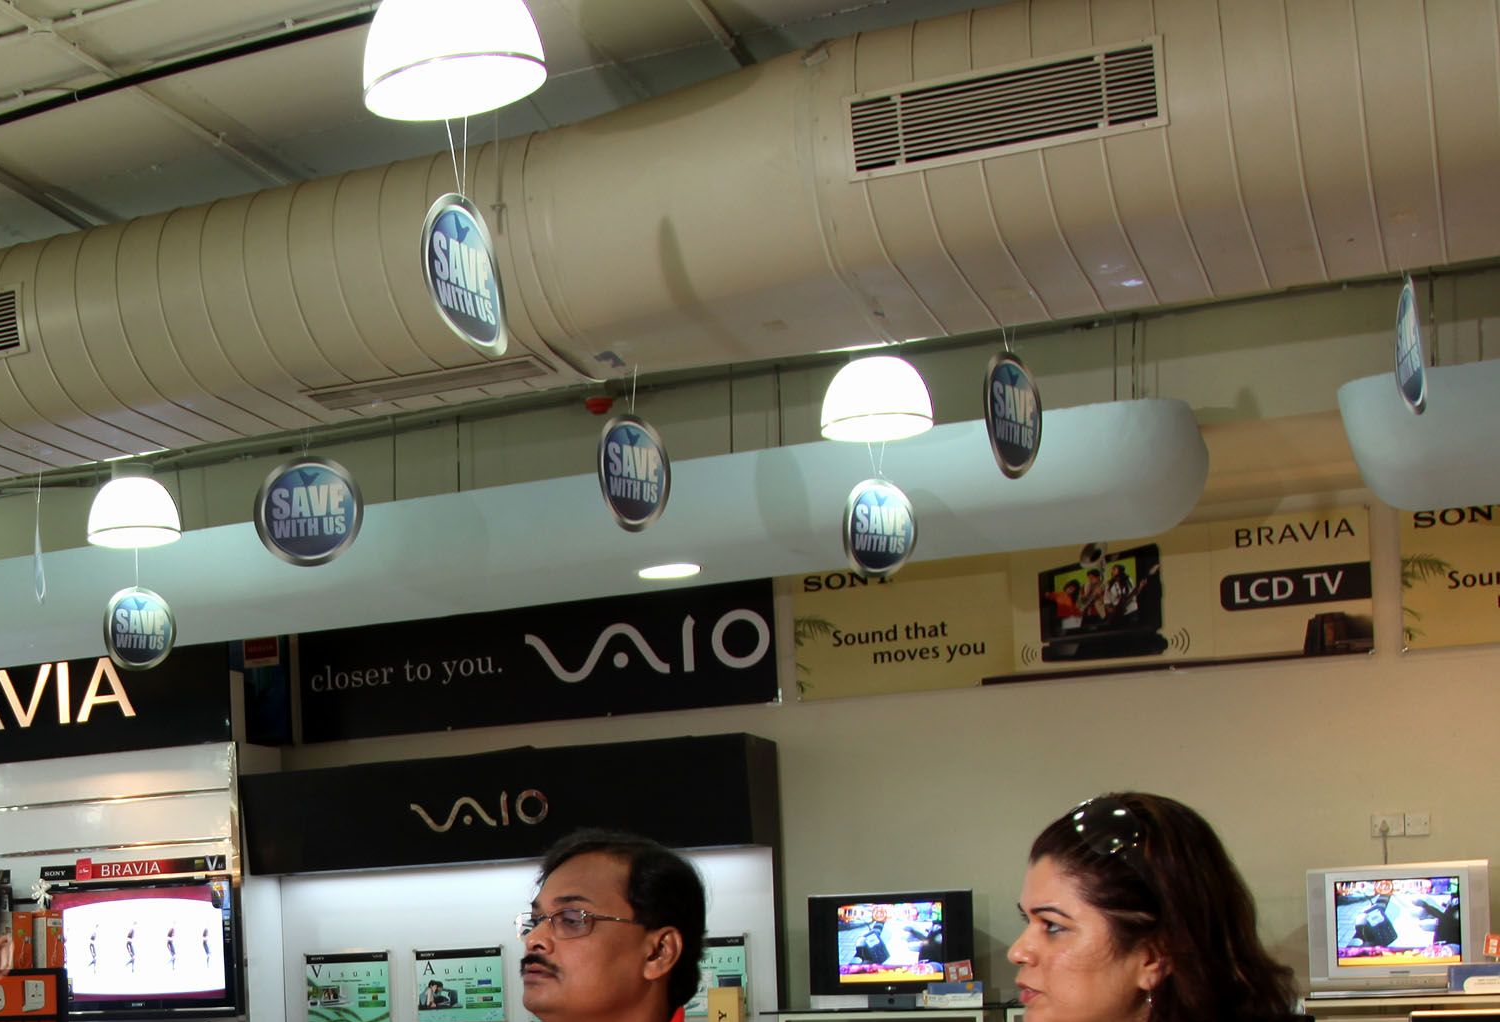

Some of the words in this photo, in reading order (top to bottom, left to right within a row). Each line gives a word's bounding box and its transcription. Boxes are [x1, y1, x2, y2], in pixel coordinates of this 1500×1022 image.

[432, 231, 491, 299] SAVE
[435, 279, 477, 318] WITH
[476, 295, 496, 326] US
[992, 380, 1036, 428] SAVE
[995, 417, 1020, 445] WITH
[1021, 426, 1034, 449] US
[607, 441, 661, 483] SAVE
[271, 482, 346, 520] SAVE
[609, 476, 641, 501] WITH
[642, 481, 659, 504] US
[272, 517, 319, 539] WITH
[322, 515, 347, 536] US
[855, 503, 907, 537] SAVE
[1413, 504, 1500, 529] SON
[854, 532, 887, 553] WITH
[888, 535, 905, 554] US
[1234, 517, 1355, 548] BRAVIA
[1233, 576, 1294, 604] LCD
[1302, 570, 1344, 597] TV
[115, 608, 165, 635] SAVE
[832, 624, 898, 648] Sound
[904, 621, 949, 642] that
[116, 633, 147, 649] WITH
[149, 635, 165, 650] US
[524, 608, 771, 683] VAIO
[873, 645, 940, 665] moves
[945, 641, 986, 663] you
[311, 664, 394, 693] closer
[404, 659, 432, 682] to
[441, 655, 503, 686] you.
[410, 788, 549, 833] VAIO
[101, 861, 161, 877] BRAVIA
[311, 964, 383, 979] Visual
[423, 961, 492, 976] Audio
